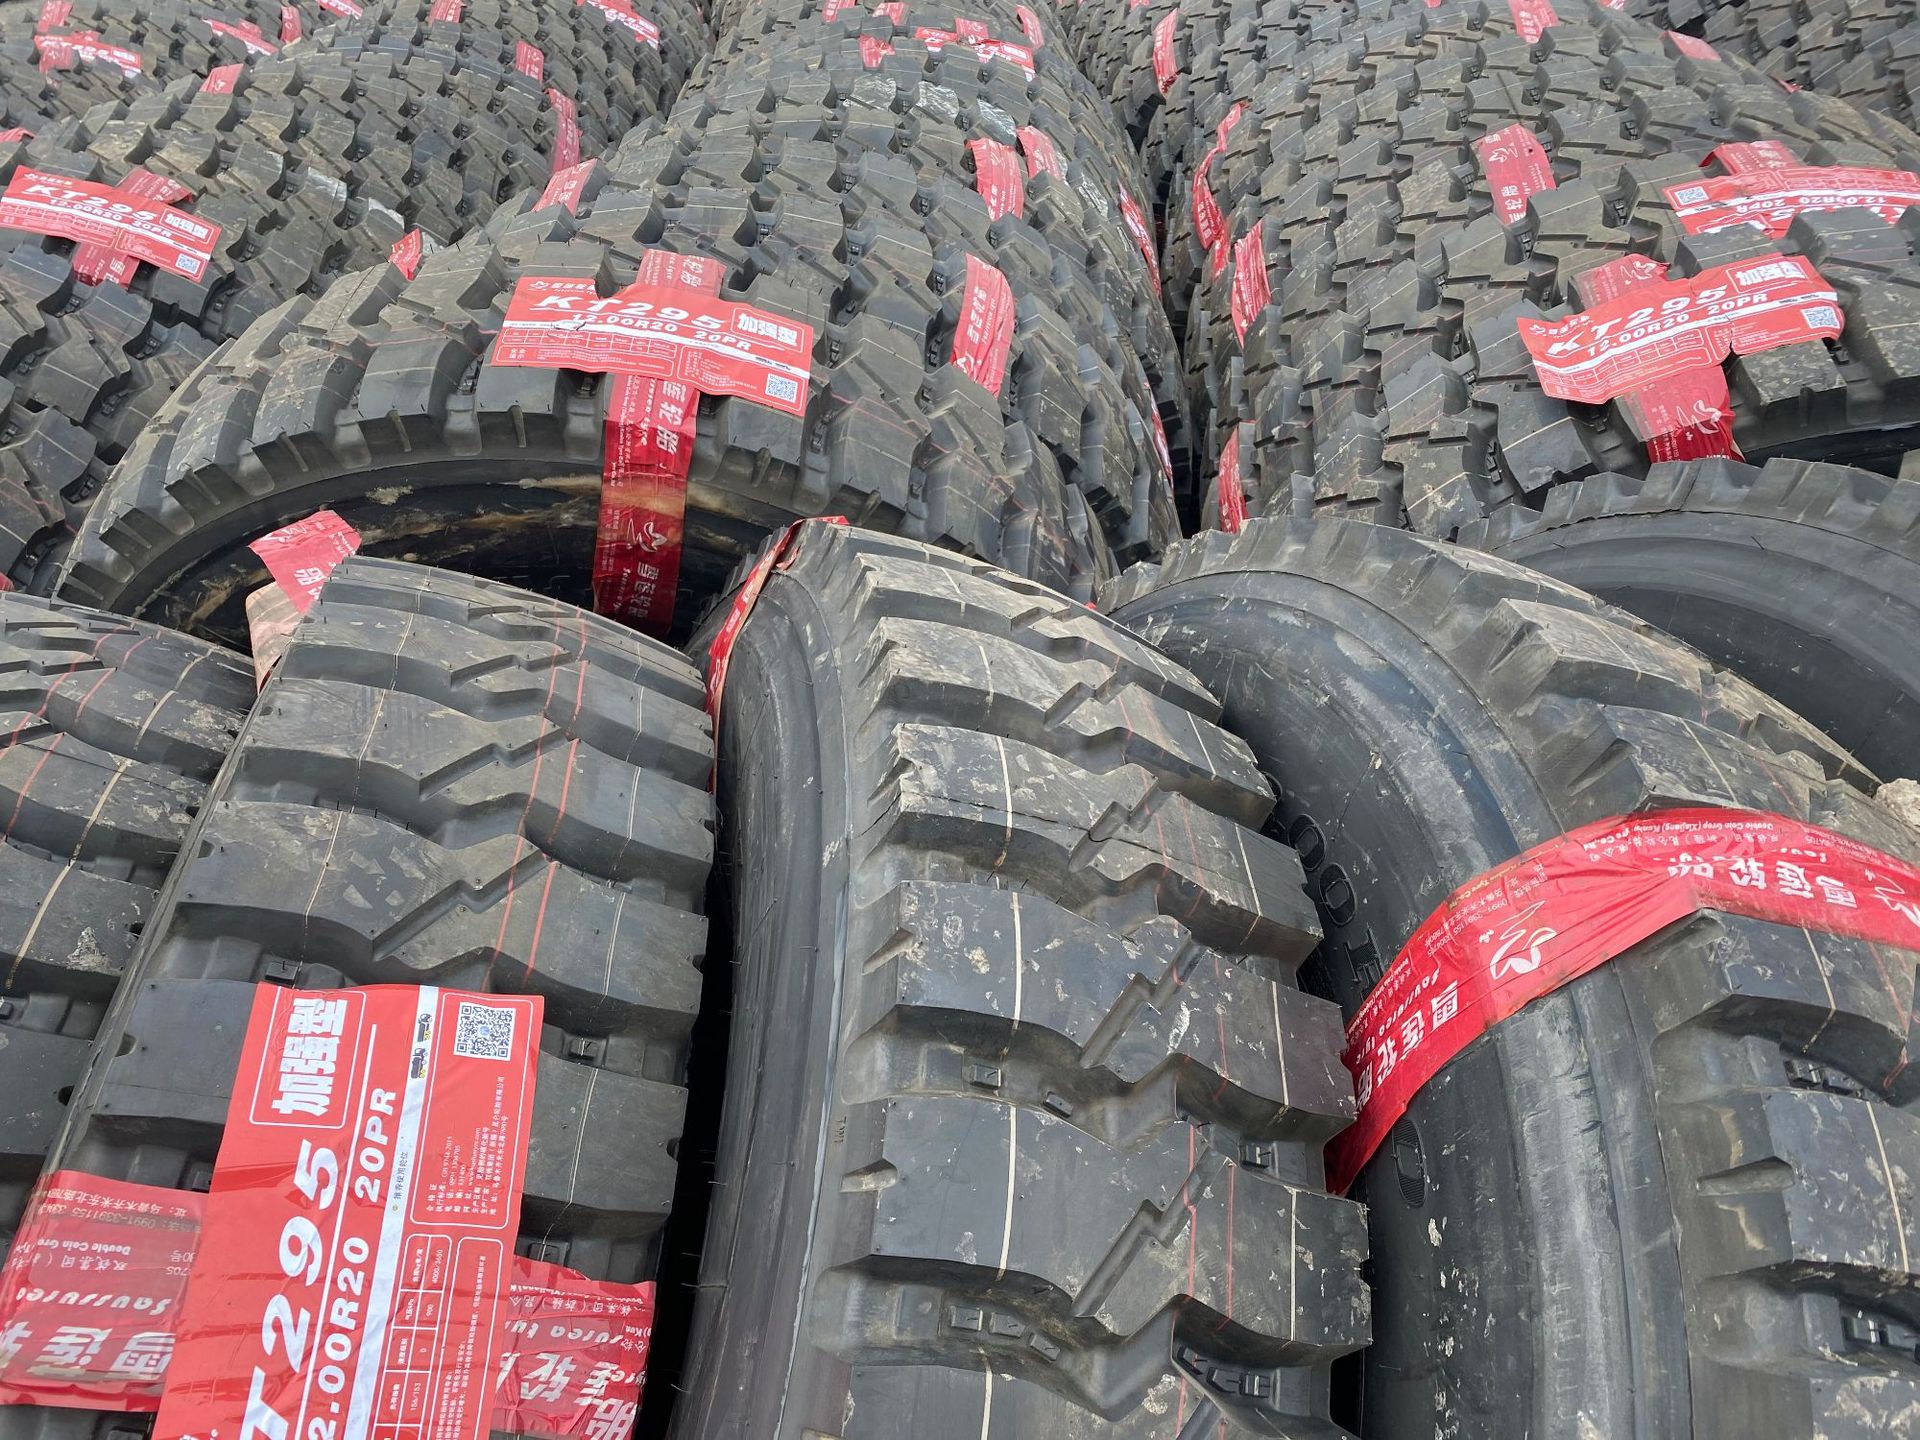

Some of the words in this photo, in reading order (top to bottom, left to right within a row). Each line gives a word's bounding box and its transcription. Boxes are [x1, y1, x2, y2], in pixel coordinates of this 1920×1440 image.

[23, 185, 158, 221] KT295
[536, 295, 728, 331] KT295
[737, 313, 798, 347] 加强型
[1547, 284, 1728, 355] KT295
[1587, 313, 1689, 357] 12.00R20
[1707, 292, 1768, 316] 20PR
[571, 313, 679, 333] 12.00R20
[694, 329, 752, 352] 20PR
[271, 997, 348, 1118] 加强型
[354, 1087, 397, 1203] 20PR
[62, 1240, 89, 1251] Coin
[91, 1243, 131, 1255] Double
